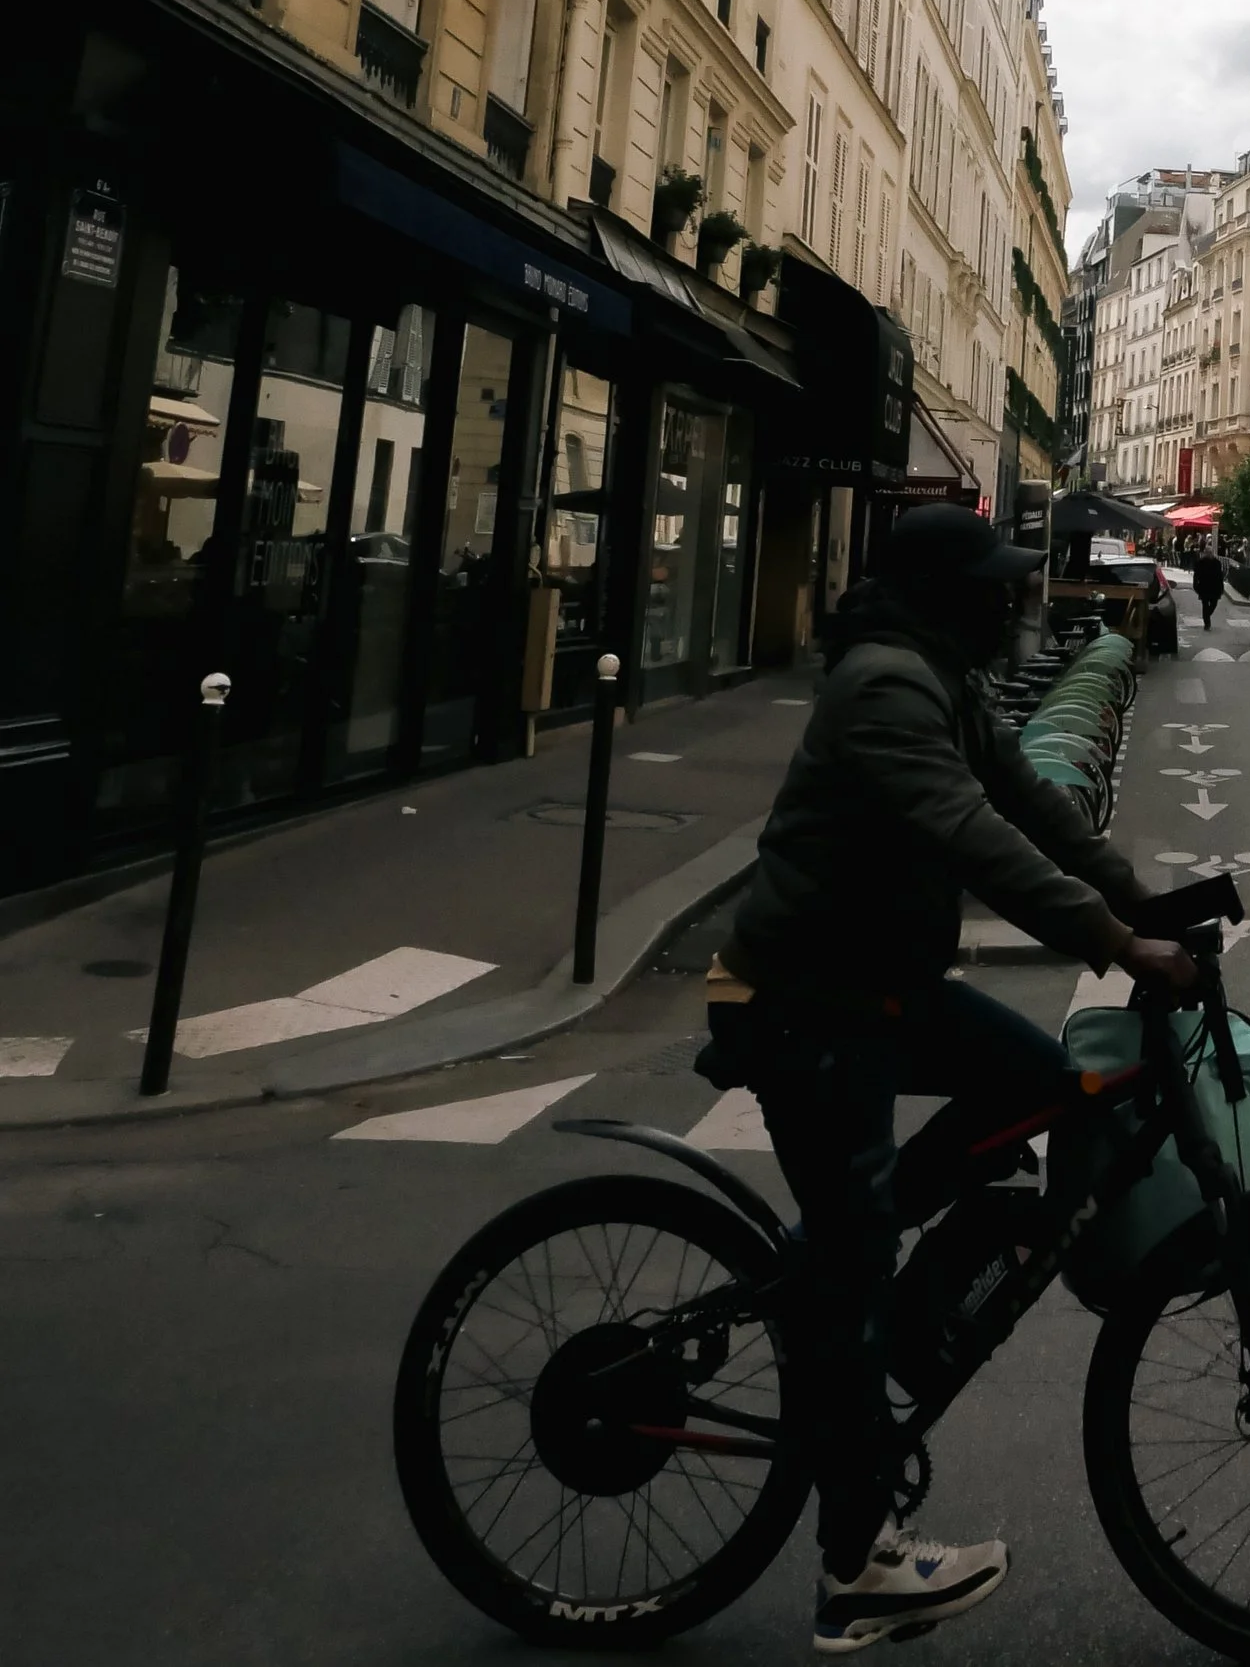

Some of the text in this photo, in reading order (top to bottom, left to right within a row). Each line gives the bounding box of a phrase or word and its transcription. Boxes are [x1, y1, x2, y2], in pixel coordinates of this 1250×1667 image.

[884, 393, 902, 434] CLUB
[818, 457, 862, 472] CLUB
[549, 1595, 664, 1622] MTX
